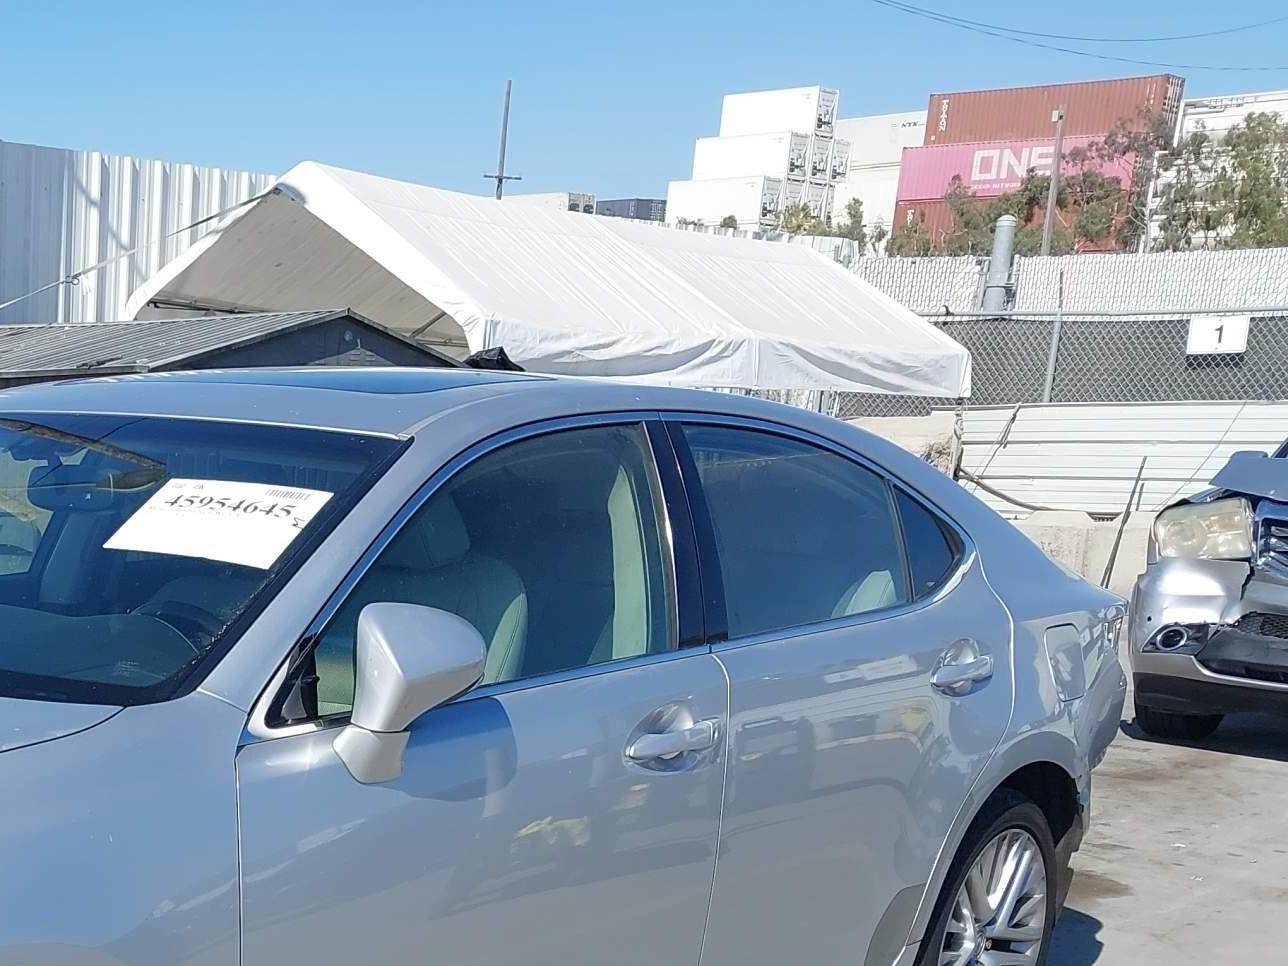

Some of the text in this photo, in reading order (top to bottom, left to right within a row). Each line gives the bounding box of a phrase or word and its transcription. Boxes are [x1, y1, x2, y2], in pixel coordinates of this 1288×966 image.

[971, 146, 1056, 181] ONE
[1214, 324, 1224, 344] 1
[165, 494, 297, 518] 45954645
